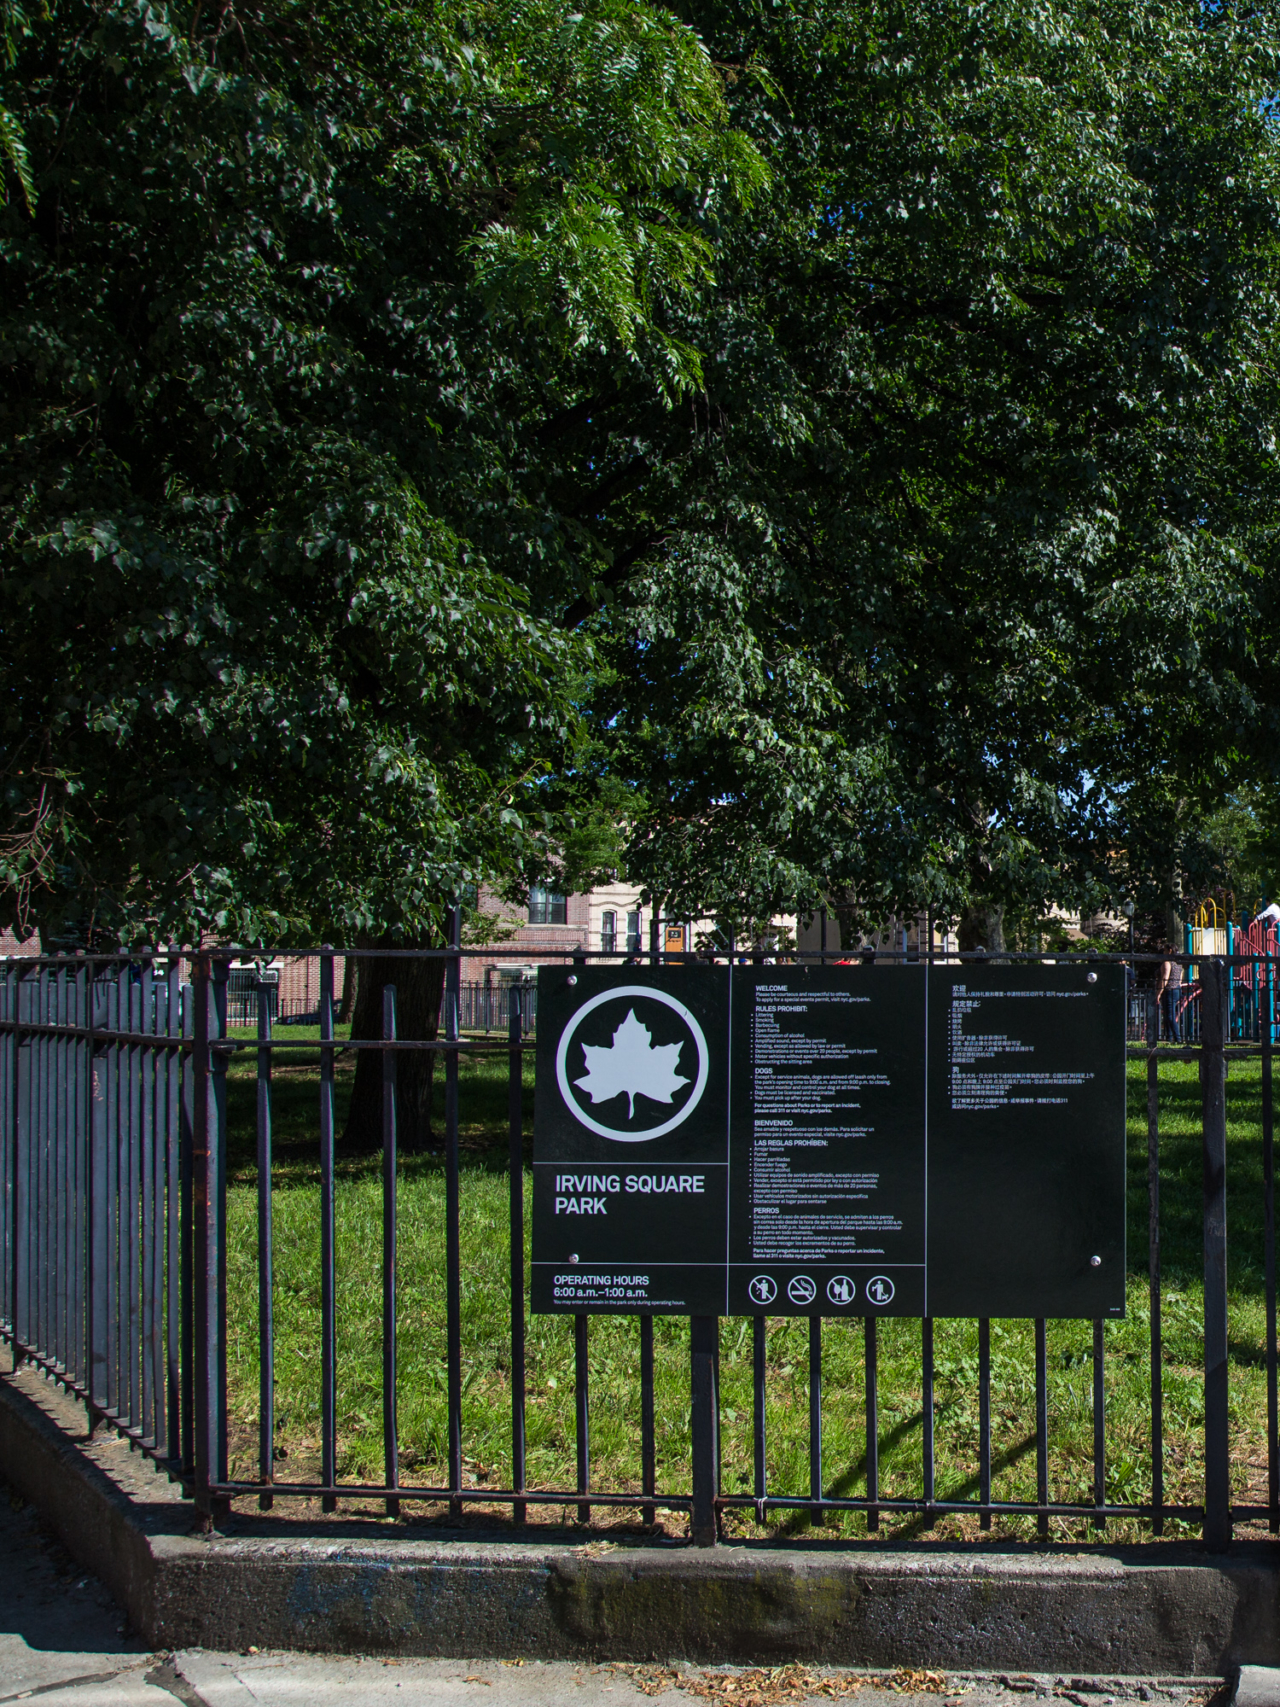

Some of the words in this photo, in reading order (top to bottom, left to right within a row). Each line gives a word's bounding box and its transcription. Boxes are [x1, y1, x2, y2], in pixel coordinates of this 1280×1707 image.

[754, 1138, 766, 1146] LAS
[768, 1138, 793, 1146] REGLAS
[794, 1138, 828, 1146] PROHÍBEN:
[555, 1175, 620, 1192] IRVING
[625, 1175, 705, 1193] SQUARE
[555, 1197, 607, 1214] PARK
[554, 1275, 611, 1285] OPERATING
[613, 1276, 649, 1285] HOURS
[554, 1288, 575, 1297] 6:00
[577, 1288, 624, 1297] a.m.–1:00
[626, 1288, 648, 1297] a.m.
